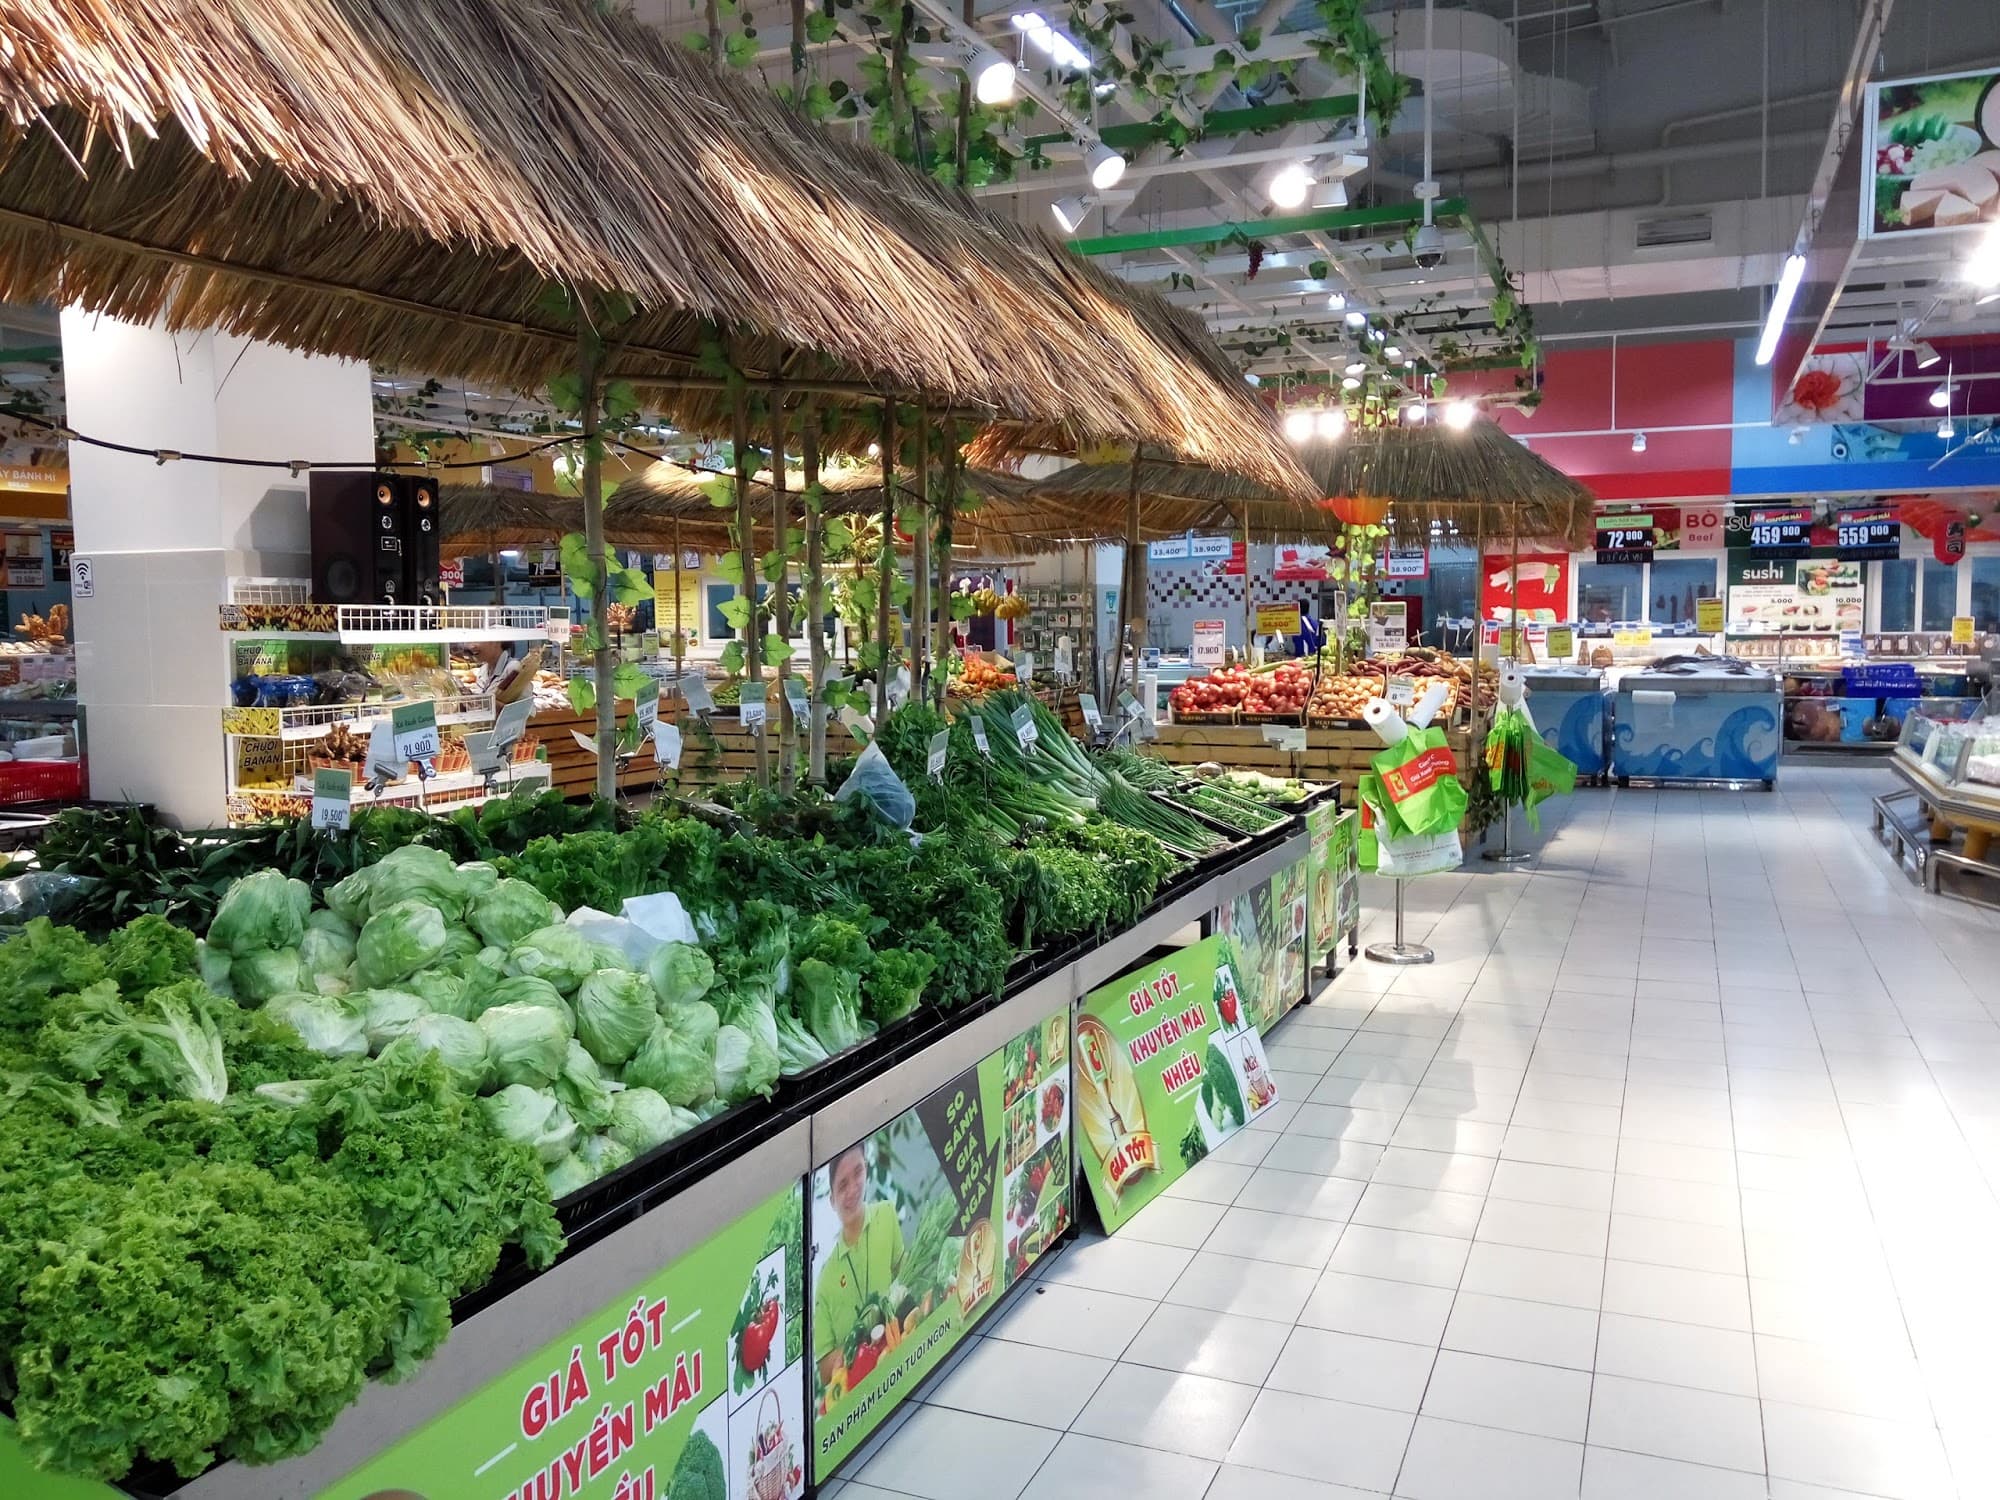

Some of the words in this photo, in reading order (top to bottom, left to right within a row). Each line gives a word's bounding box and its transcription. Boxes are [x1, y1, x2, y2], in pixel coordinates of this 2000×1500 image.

[1686, 510, 1718, 528] BÒ
[1751, 526, 1780, 545] 459
[1838, 526, 1869, 546] 559
[1607, 530, 1625, 549] 72
[1625, 530, 1643, 541] 900
[1688, 534, 1713, 542] Beef
[1742, 560, 1784, 580] sushi
[238, 657, 273, 666] BANANA
[1128, 981, 1155, 1016] GIÁ
[1152, 968, 1180, 1002] TỐT
[1128, 1014, 1182, 1065] KHUYẾN
[1180, 1002, 1207, 1034] MÃI
[1161, 1049, 1201, 1094] NHIỀU
[946, 1090, 965, 1125] SO
[944, 1098, 979, 1162] SÁNH
[956, 1131, 978, 1173] GIÁ
[1109, 1146, 1128, 1182] GIÁ
[1124, 1136, 1147, 1162] TỐT
[927, 1318, 951, 1350] NGON
[521, 1346, 590, 1438] GIÁ
[598, 1298, 667, 1382] TỐT
[644, 1351, 702, 1434] MÃI
